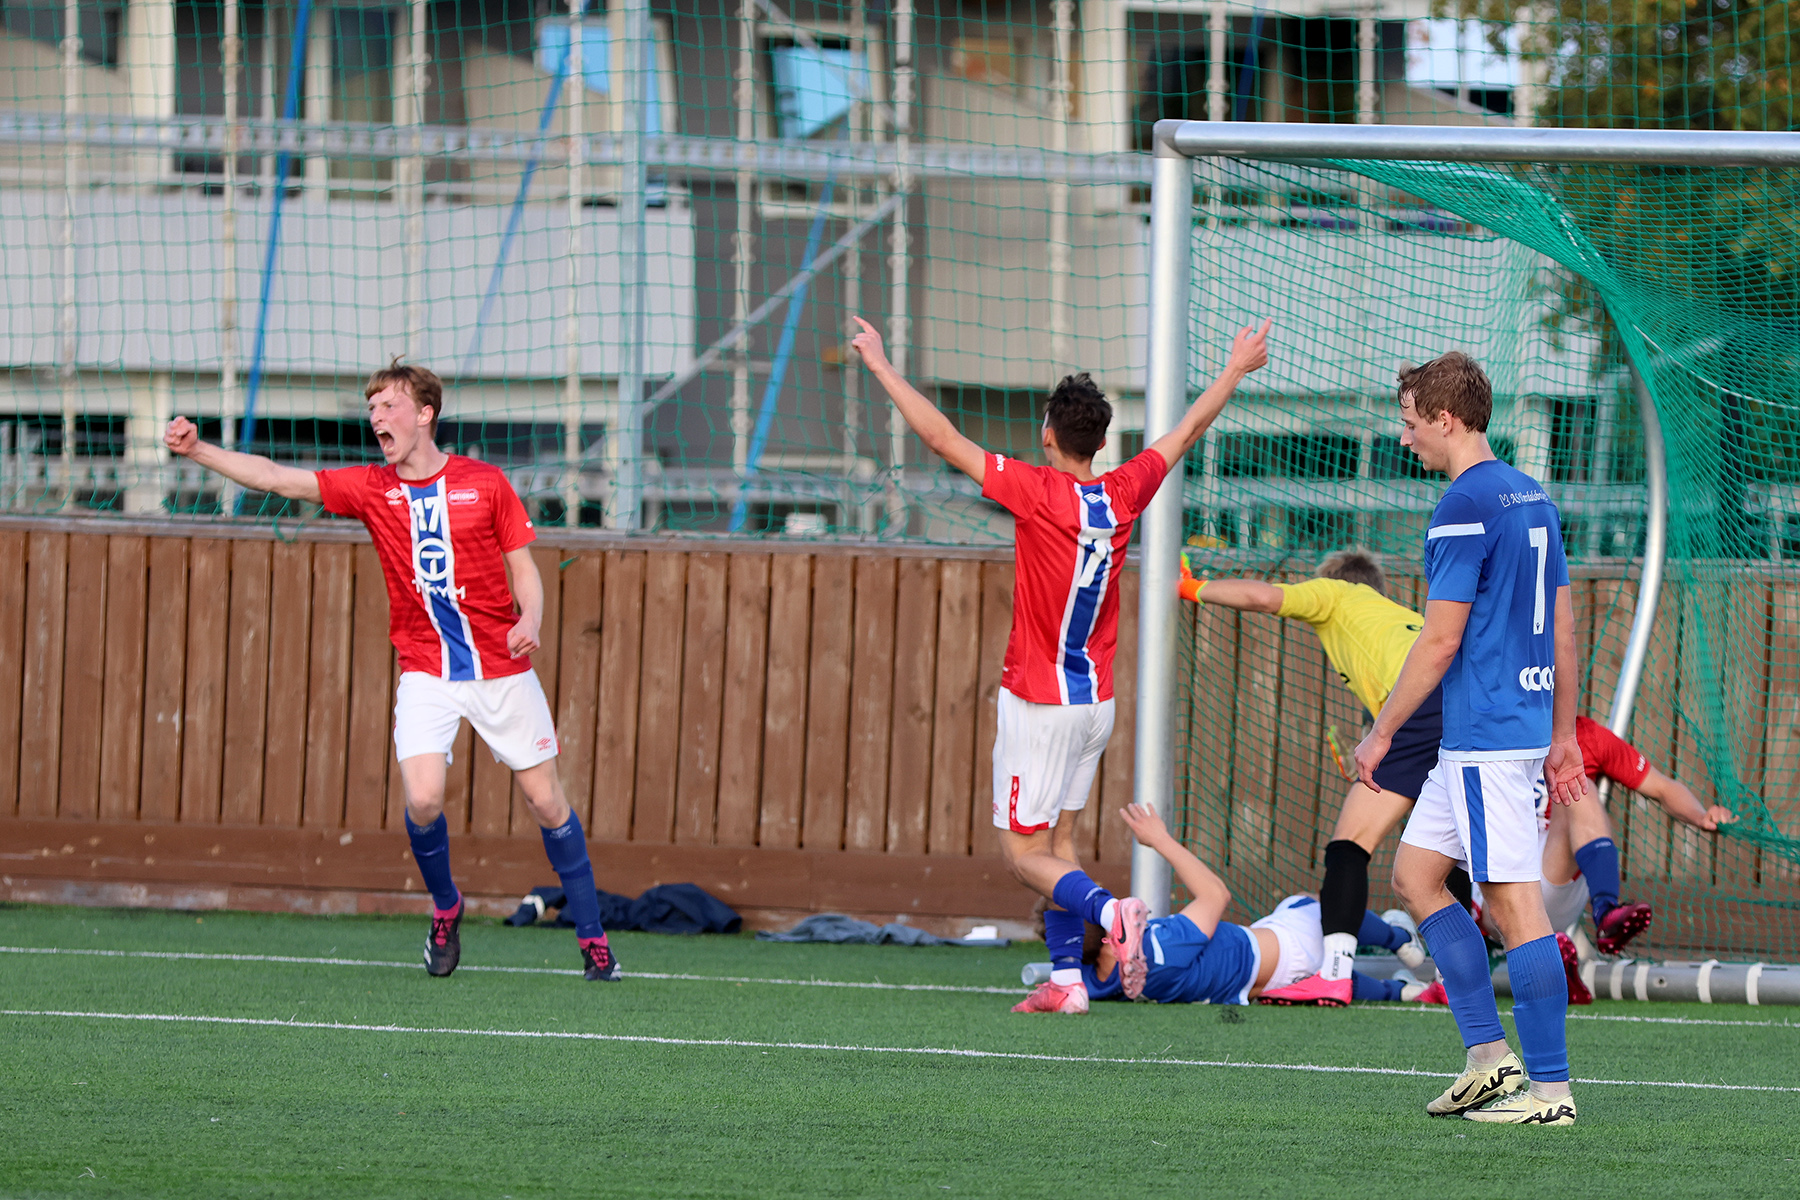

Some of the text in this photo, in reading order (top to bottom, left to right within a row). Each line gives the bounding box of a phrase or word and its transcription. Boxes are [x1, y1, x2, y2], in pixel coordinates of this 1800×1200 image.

[411, 496, 441, 533] 17
[1077, 526, 1116, 588] 7
[1528, 526, 1549, 635] 7
